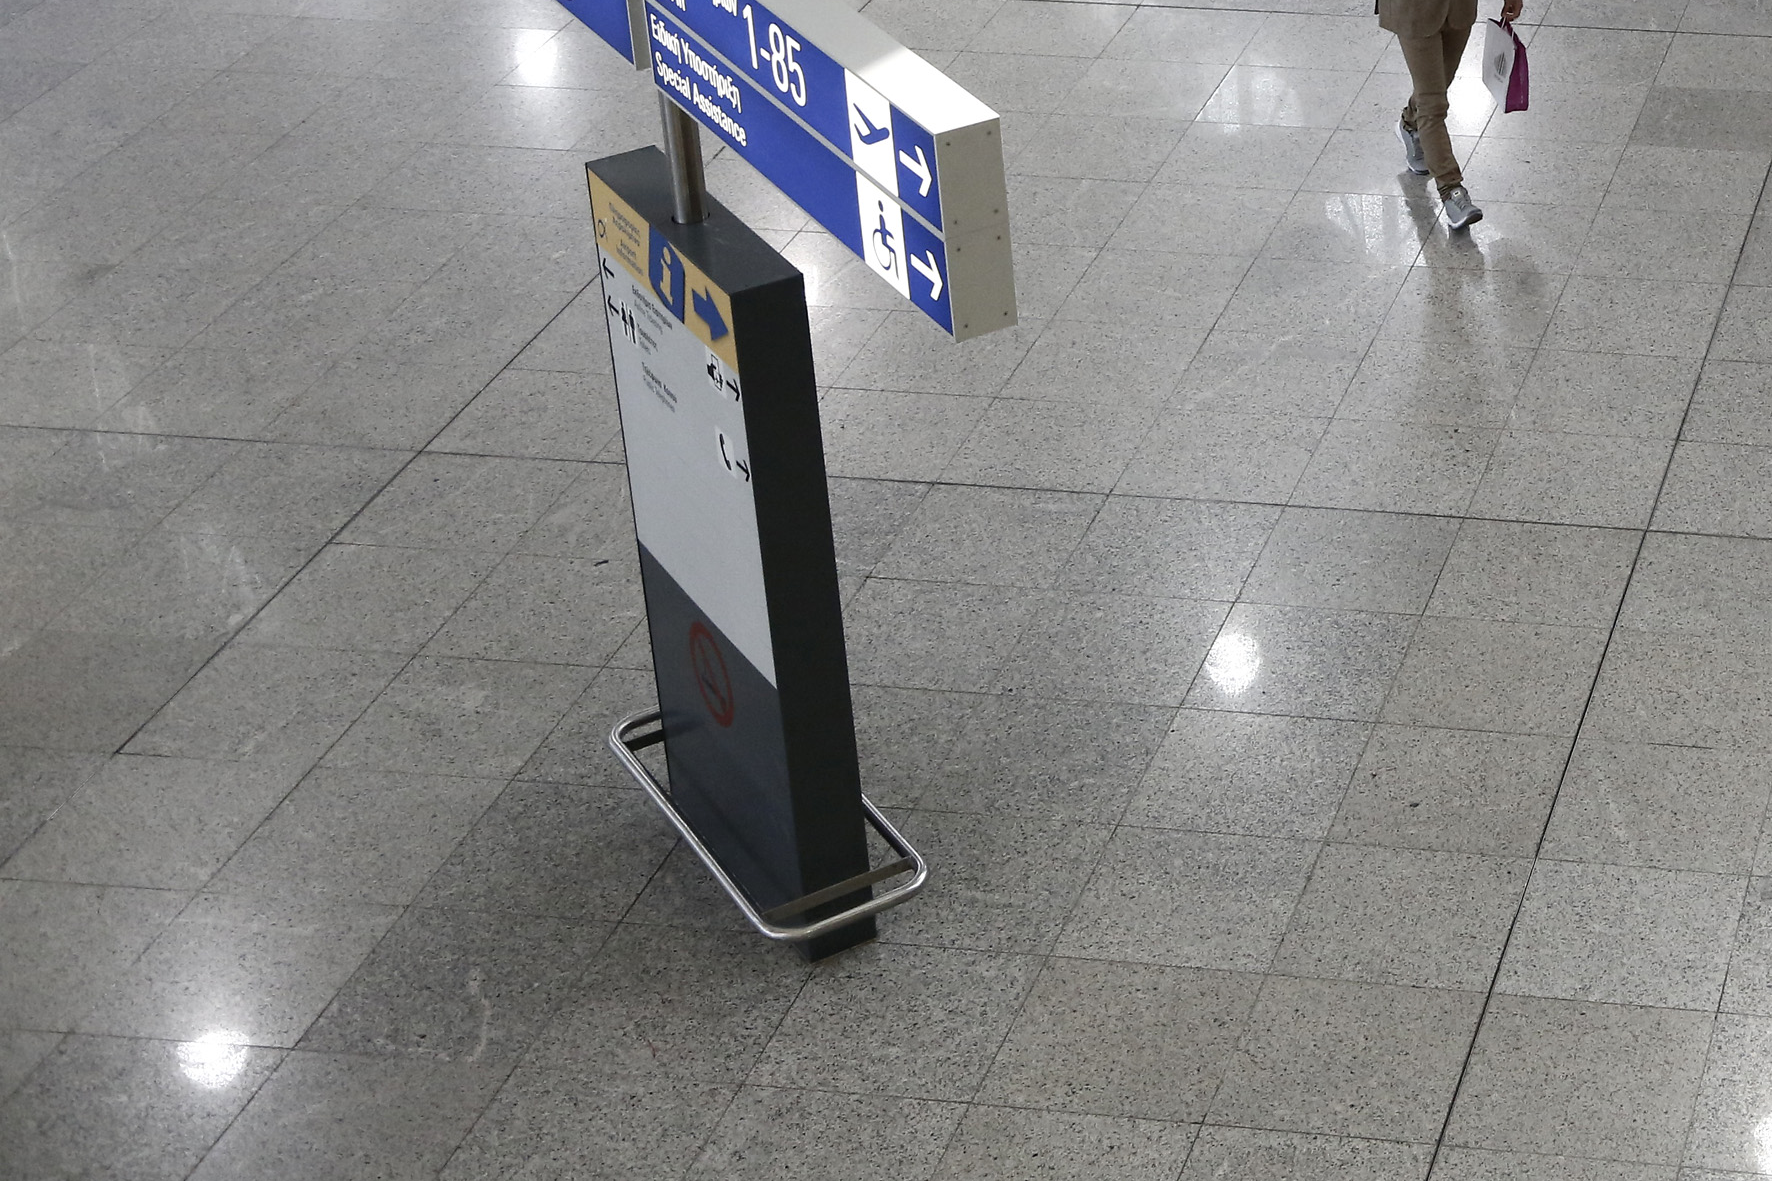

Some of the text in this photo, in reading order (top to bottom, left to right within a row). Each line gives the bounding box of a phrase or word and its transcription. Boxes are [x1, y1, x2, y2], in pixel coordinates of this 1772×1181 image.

[650, 13, 742, 115] Ειδική Υποστήριξη
[655, 54, 747, 148] Special Assistance
[742, 3, 808, 108] 1-85
